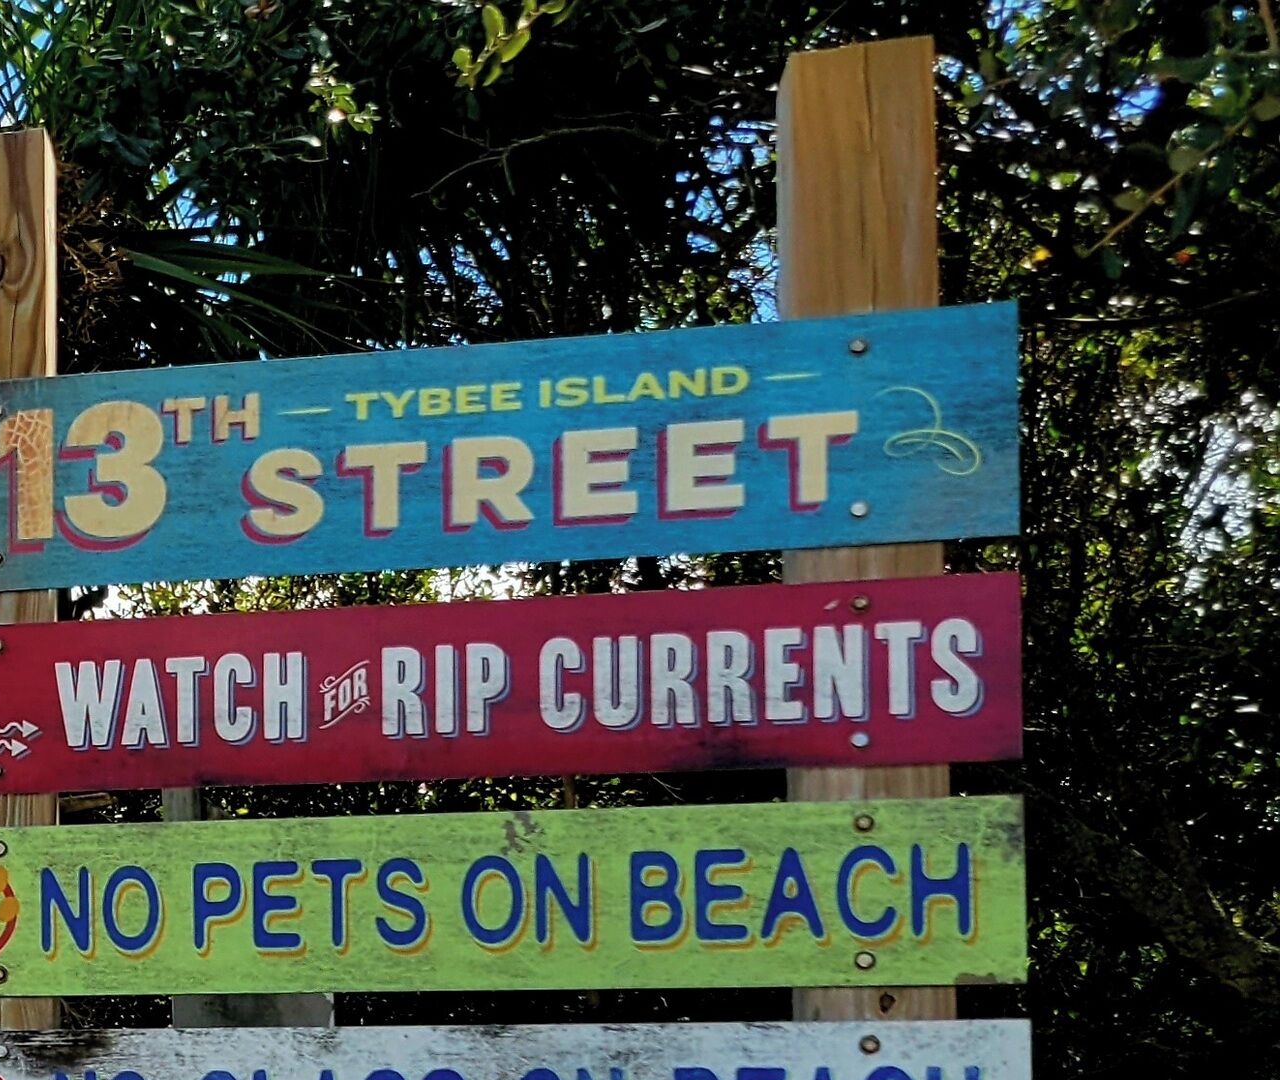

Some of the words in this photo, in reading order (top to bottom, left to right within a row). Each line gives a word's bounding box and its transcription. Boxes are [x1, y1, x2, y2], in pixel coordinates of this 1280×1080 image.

[345, 382, 522, 421] TYBEE
[539, 366, 750, 408] ISLAND
[242, 410, 859, 546] STREET
[54, 651, 309, 751] WATCH
[322, 666, 370, 724] FOR
[381, 642, 510, 739] RIP
[539, 618, 984, 734] CURRENTS
[40, 864, 165, 960] NO
[193, 857, 432, 958] PETS
[461, 852, 598, 953] ON
[629, 842, 978, 950] BEACH
